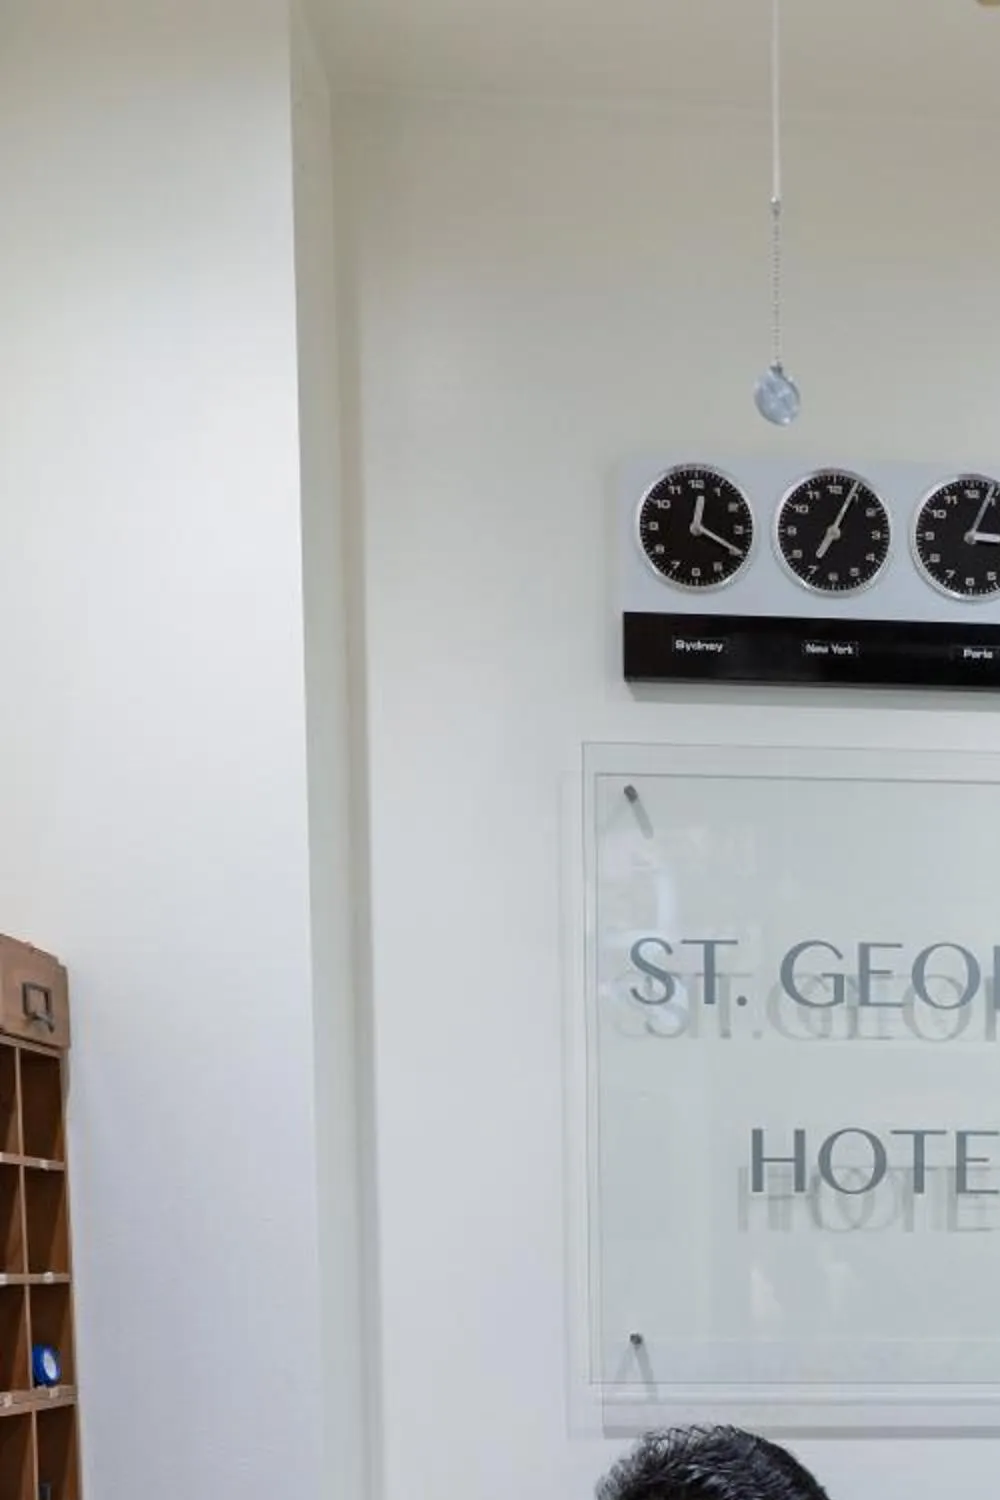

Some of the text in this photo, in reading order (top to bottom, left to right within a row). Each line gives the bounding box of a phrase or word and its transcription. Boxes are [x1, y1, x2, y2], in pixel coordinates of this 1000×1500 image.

[668, 485, 681, 495] 11
[713, 486, 721, 497] 1
[807, 491, 820, 500] 11
[943, 495, 957, 505] 11
[657, 499, 671, 509] 10
[792, 504, 809, 515] 10
[932, 509, 947, 519] 10
[671, 560, 680, 570] 7
[808, 565, 818, 575] 7
[945, 569, 955, 579] 7
[675, 639, 723, 653] Sydney
[805, 643, 853, 655] New York
[963, 648, 993, 659] Paris
[630, 937, 748, 1006] ST.
